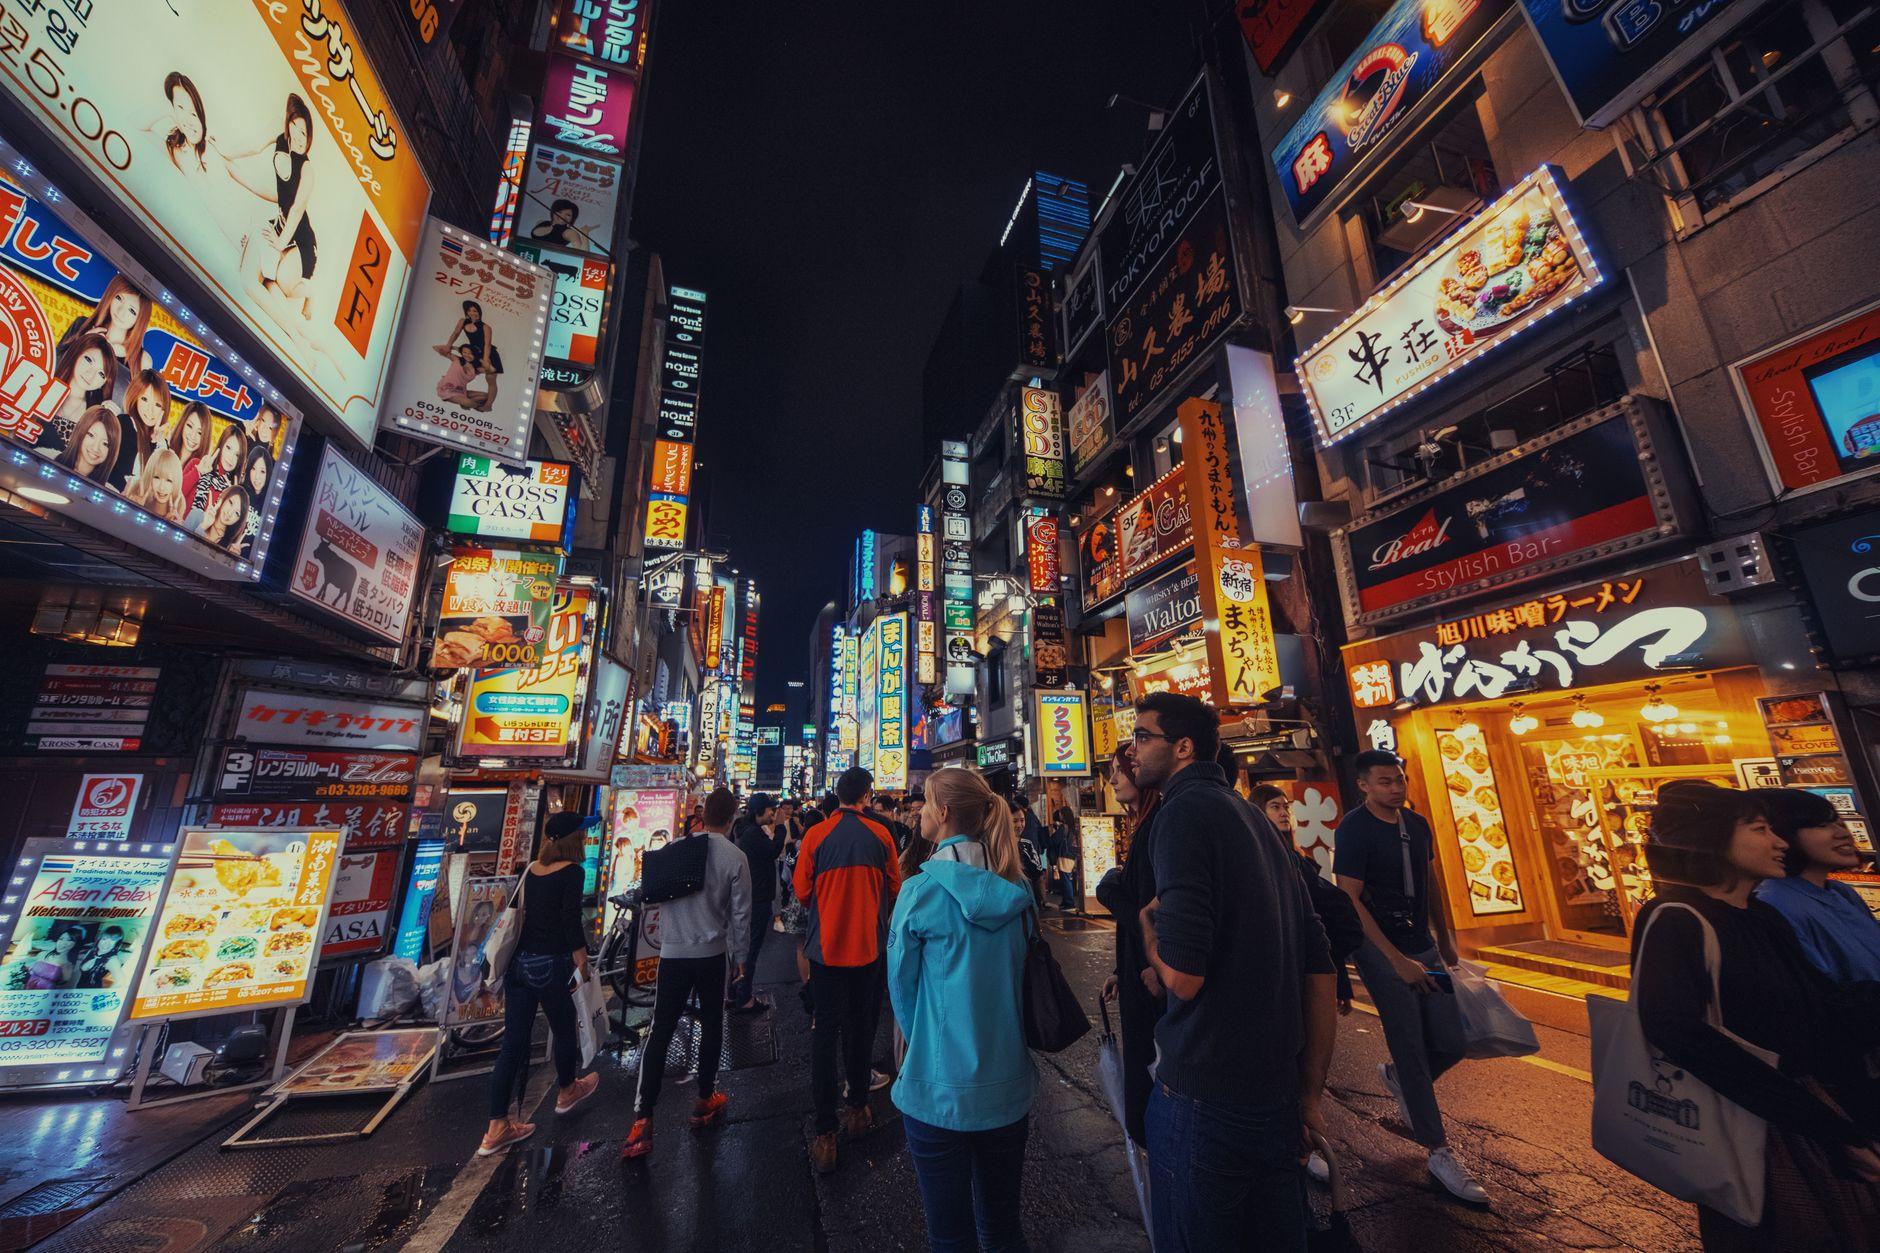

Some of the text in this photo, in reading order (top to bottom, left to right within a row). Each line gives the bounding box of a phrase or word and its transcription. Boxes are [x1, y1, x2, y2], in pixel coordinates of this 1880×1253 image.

[293, 30, 383, 197] Massage
[1347, 54, 1416, 148] Great Blue
[344, 237, 380, 331] 2F
[434, 272, 463, 287] 2F
[440, 252, 535, 300] マッサージ
[1149, 296, 1231, 391] 03-5155-0916
[161, 341, 254, 411] 即デート
[1395, 353, 1440, 385] KUSHISO
[417, 400, 445, 415] 60分
[1331, 401, 1357, 428] 3F
[404, 407, 510, 445] 03-3207-5527
[1024, 389, 1051, 455] GOD
[462, 456, 477, 469] 肉
[471, 468, 488, 477] バル
[542, 466, 568, 478] イタリ
[1026, 456, 1064, 479] 麻雀
[1197, 409, 1231, 533] 九州のうまかもん
[327, 461, 390, 516] ヘルシー
[461, 477, 559, 505] XROSS
[544, 474, 564, 484] アン
[1043, 478, 1064, 494] 4F
[319, 482, 371, 532] 肉バル
[471, 500, 546, 522] CASA
[652, 502, 681, 539] らーめん
[1121, 512, 1138, 533] 3F
[1411, 524, 1436, 540] レアル
[1368, 516, 1453, 572] Real
[1036, 543, 1048, 587] カリーナ
[1220, 570, 1253, 593] 新宿
[357, 577, 405, 614] 高タンパク
[1233, 591, 1245, 601] の
[352, 599, 401, 631] 低カロリー
[1435, 576, 1645, 648] 旭川味噌ラーメン
[1224, 604, 1256, 698] まっちゃん
[1399, 606, 1708, 703] ばんから
[880, 622, 904, 747] まんが喫茶
[1045, 674, 1058, 685] 2F
[39, 740, 121, 749] XROSS CASA
[1053, 705, 1074, 761] クラウン
[1791, 741, 1839, 751] CLOVER
[257, 760, 340, 778] レンタルルーム
[341, 757, 412, 783] Eden
[80, 808, 128, 816] 防犯カメラ
[77, 821, 123, 831] すてるな
[75, 868, 115, 876] Traditional
[33, 877, 158, 902] Asian Relax
[26, 905, 84, 918] Welcome
[0, 1037, 107, 1051] 03-3207-5527
